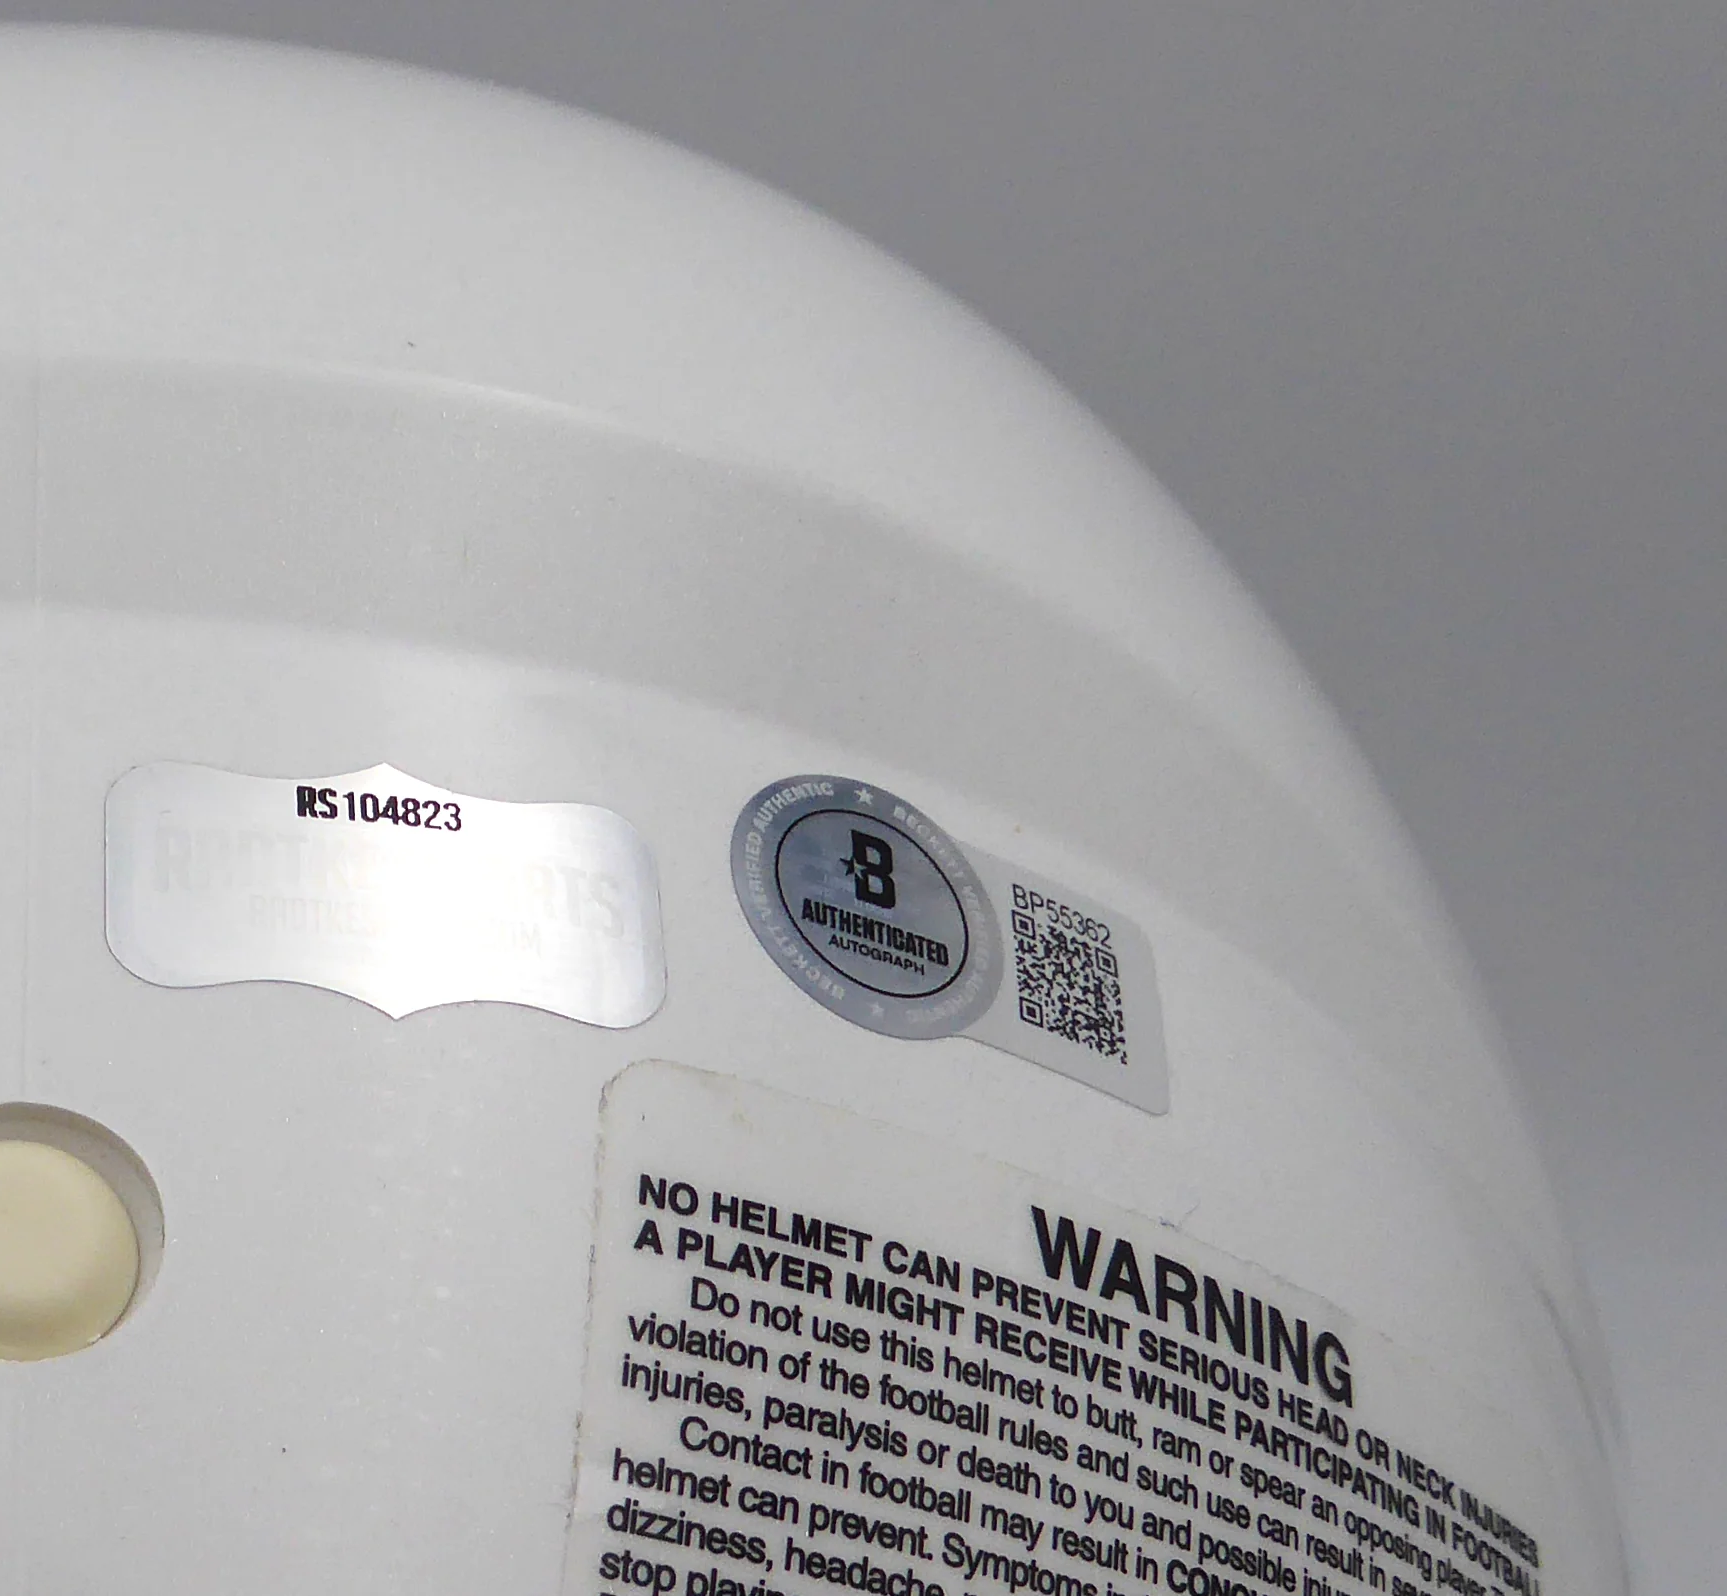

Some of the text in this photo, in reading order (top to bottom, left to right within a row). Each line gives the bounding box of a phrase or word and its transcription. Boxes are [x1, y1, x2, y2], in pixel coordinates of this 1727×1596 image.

[296, 785, 462, 832] RS104823
[753, 782, 834, 833] AUTHENTIC
[745, 831, 772, 921] VERIFIED
[801, 897, 950, 967] AUTHENTICATED
[1012, 883, 1112, 949] BP55362
[828, 934, 926, 976] AUTOGRAPH
[638, 1173, 698, 1216] NO
[712, 1192, 873, 1262] HELMET
[882, 1241, 960, 1292] CAN
[972, 1267, 1130, 1350] PREVENT
[1138, 1329, 1270, 1409] SERIOUS
[1277, 1388, 1349, 1447] HEAD
[1356, 1429, 1390, 1471] OR
[1396, 1449, 1456, 1510] NECK
[1031, 1205, 1353, 1408] WARNING
[633, 1219, 663, 1254] A
[676, 1227, 833, 1298] PLAYER
[845, 1272, 965, 1336] MIGHT
[975, 1311, 1122, 1392] RECEIVE
[1128, 1366, 1226, 1434] WHILE
[1235, 1409, 1419, 1528] PARTICIPATING
[1425, 1505, 1446, 1544] IN
[690, 1276, 740, 1318] Do
[750, 1299, 802, 1336] not
[812, 1316, 870, 1353] use
[880, 1329, 934, 1372] this
[943, 1346, 1044, 1409] helmet
[1052, 1384, 1078, 1419] to
[1086, 1394, 1143, 1448] butt,
[1152, 1426, 1201, 1467] ram
[1208, 1449, 1235, 1478] or
[1240, 1462, 1306, 1510] spear
[1311, 1494, 1338, 1526] an
[1344, 1510, 1433, 1581] opposing
[612, 1448, 731, 1508] helmet
[738, 1485, 800, 1524] can
[808, 1502, 933, 1561] prevent.
[622, 1354, 752, 1421] injuries,
[763, 1396, 908, 1452] paralysis
[917, 1439, 950, 1468] or
[956, 1446, 1041, 1499] death
[1050, 1474, 1077, 1509] to
[1084, 1490, 1134, 1530] you
[1142, 1512, 1192, 1551] and
[1198, 1532, 1296, 1592] possible
[628, 1312, 768, 1372] violation
[778, 1351, 812, 1383] of
[819, 1358, 870, 1399] the
[879, 1374, 989, 1436] football
[998, 1416, 1069, 1461] rules
[1077, 1442, 1129, 1483] and
[1136, 1464, 1198, 1509] such
[1206, 1491, 1251, 1529] use
[1257, 1513, 1299, 1551] can
[1306, 1533, 1364, 1581] result
[1369, 1556, 1386, 1592] in
[679, 1416, 813, 1479] Contact
[821, 1451, 850, 1489] in
[859, 1461, 971, 1523] football
[980, 1502, 1044, 1551] may
[1052, 1525, 1128, 1574] result
[1135, 1547, 1158, 1584] in
[606, 1498, 773, 1572] dizziness,
